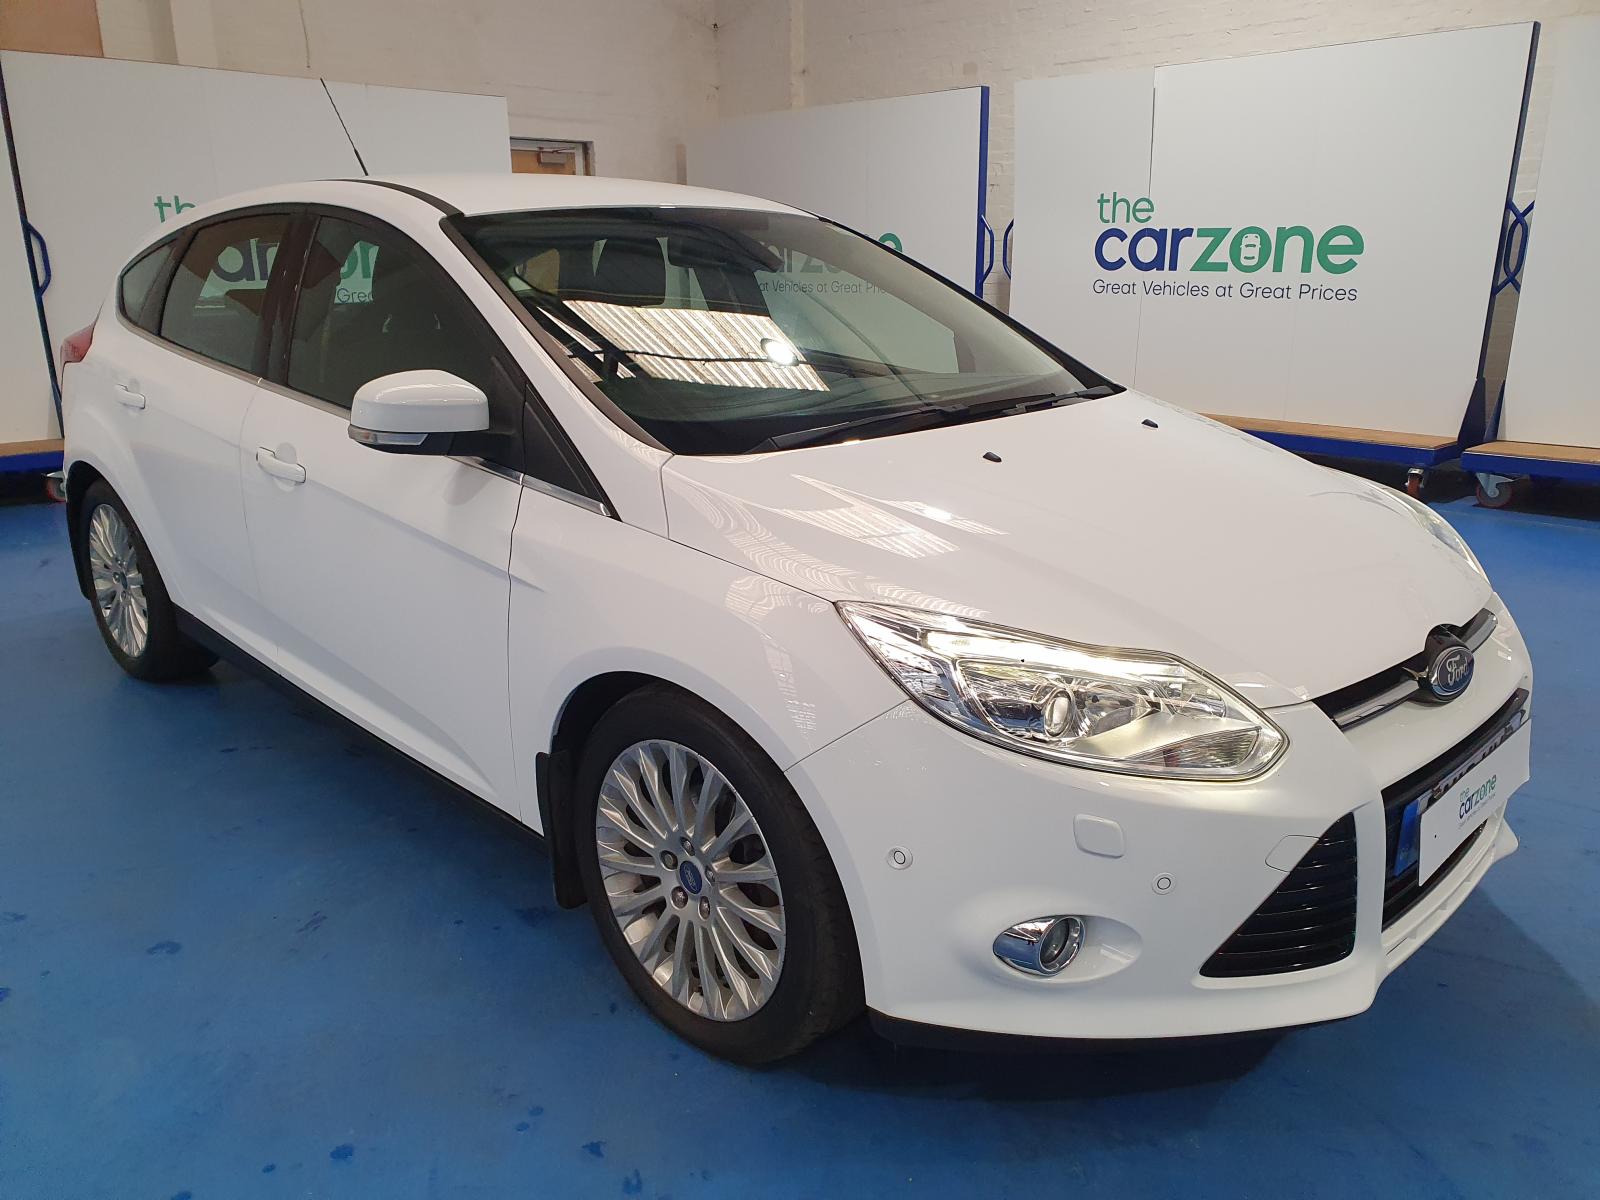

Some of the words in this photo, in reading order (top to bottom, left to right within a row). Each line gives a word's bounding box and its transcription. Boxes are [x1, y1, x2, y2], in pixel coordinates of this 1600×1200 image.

[154, 195, 196, 223] th
[1097, 192, 1155, 223] the
[1094, 225, 1365, 275] carzone
[830, 280, 861, 293] Great
[1092, 279, 1137, 295] Great
[1143, 280, 1209, 298] Vehicles
[1215, 283, 1233, 298] at
[1239, 282, 1291, 300] Great
[1299, 283, 1358, 301] Prices
[1446, 654, 1470, 687] Ford
[1459, 774, 1497, 819] carzone
